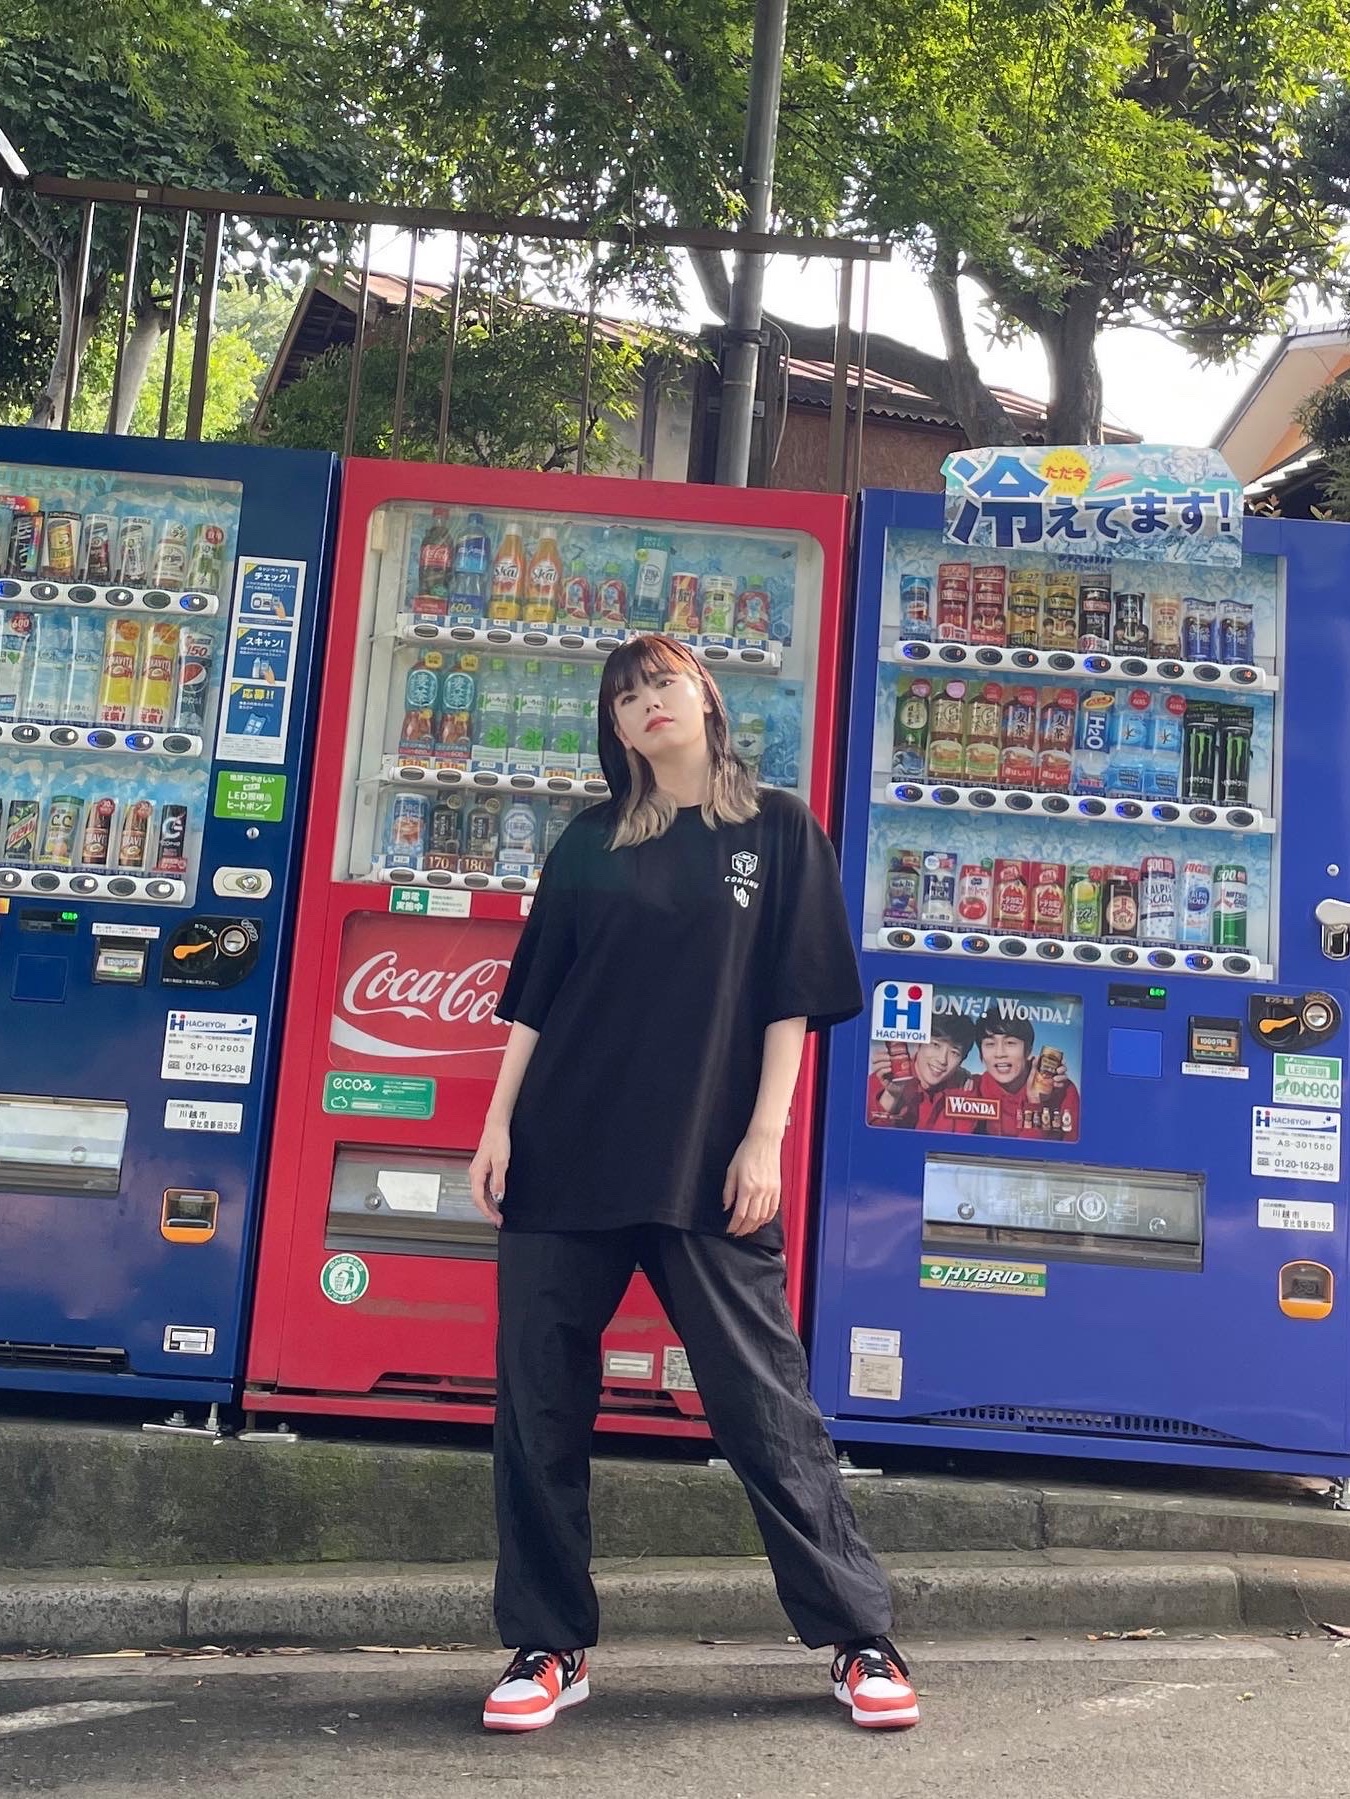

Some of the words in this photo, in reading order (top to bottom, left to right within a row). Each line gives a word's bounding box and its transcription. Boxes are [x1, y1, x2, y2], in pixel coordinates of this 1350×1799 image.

[1045, 466, 1087, 482] ただ今
[951, 455, 1231, 547] 冷えてます!
[254, 572, 290, 583] チェック!
[245, 637, 284, 648] スキャン!
[1086, 715, 1106, 750] H2O
[428, 856, 450, 869] 170
[465, 858, 487, 871] 180
[343, 951, 513, 1026] Coca-Co
[996, 997, 1072, 1025] WONDA!
[186, 1021, 226, 1029] HACHIYOH
[876, 1029, 926, 1041] HACHIYOH
[185, 1061, 246, 1074] 0120-1623-88
[949, 1097, 996, 1116] WONDA
[179, 1110, 207, 1119] 川越市
[1271, 1116, 1311, 1126] HACHIYOH
[941, 1266, 1025, 1286] HYBRID
